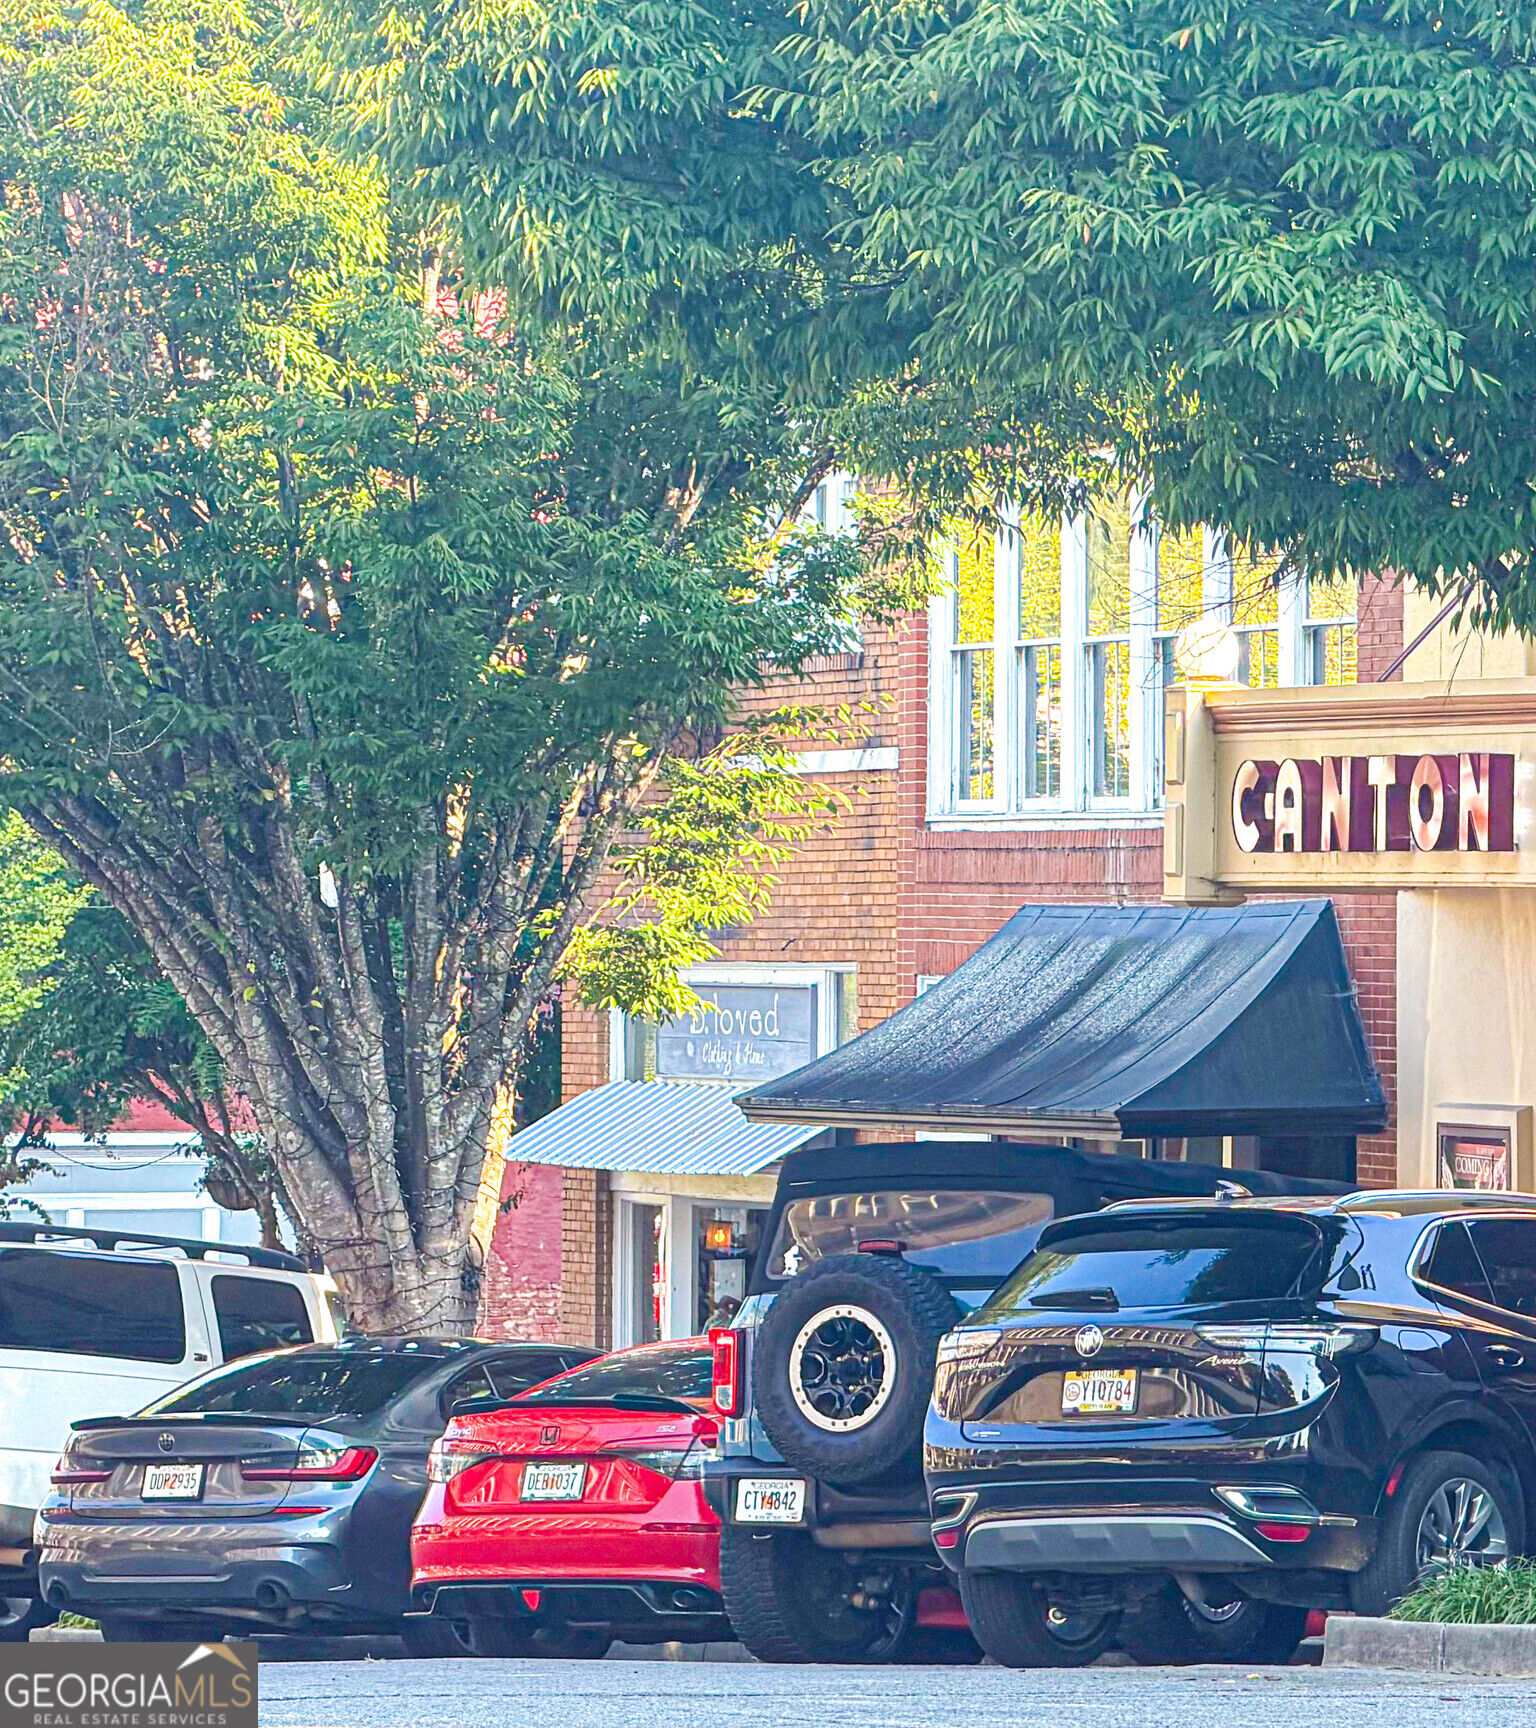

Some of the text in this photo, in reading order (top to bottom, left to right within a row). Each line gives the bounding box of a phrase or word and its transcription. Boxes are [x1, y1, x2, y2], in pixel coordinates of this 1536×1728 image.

[1231, 753, 1514, 852] CANTON
[1455, 1156, 1490, 1174] COMING
[527, 1472, 578, 1490] DEB1037
[753, 1481, 789, 1490] GEORGIA
